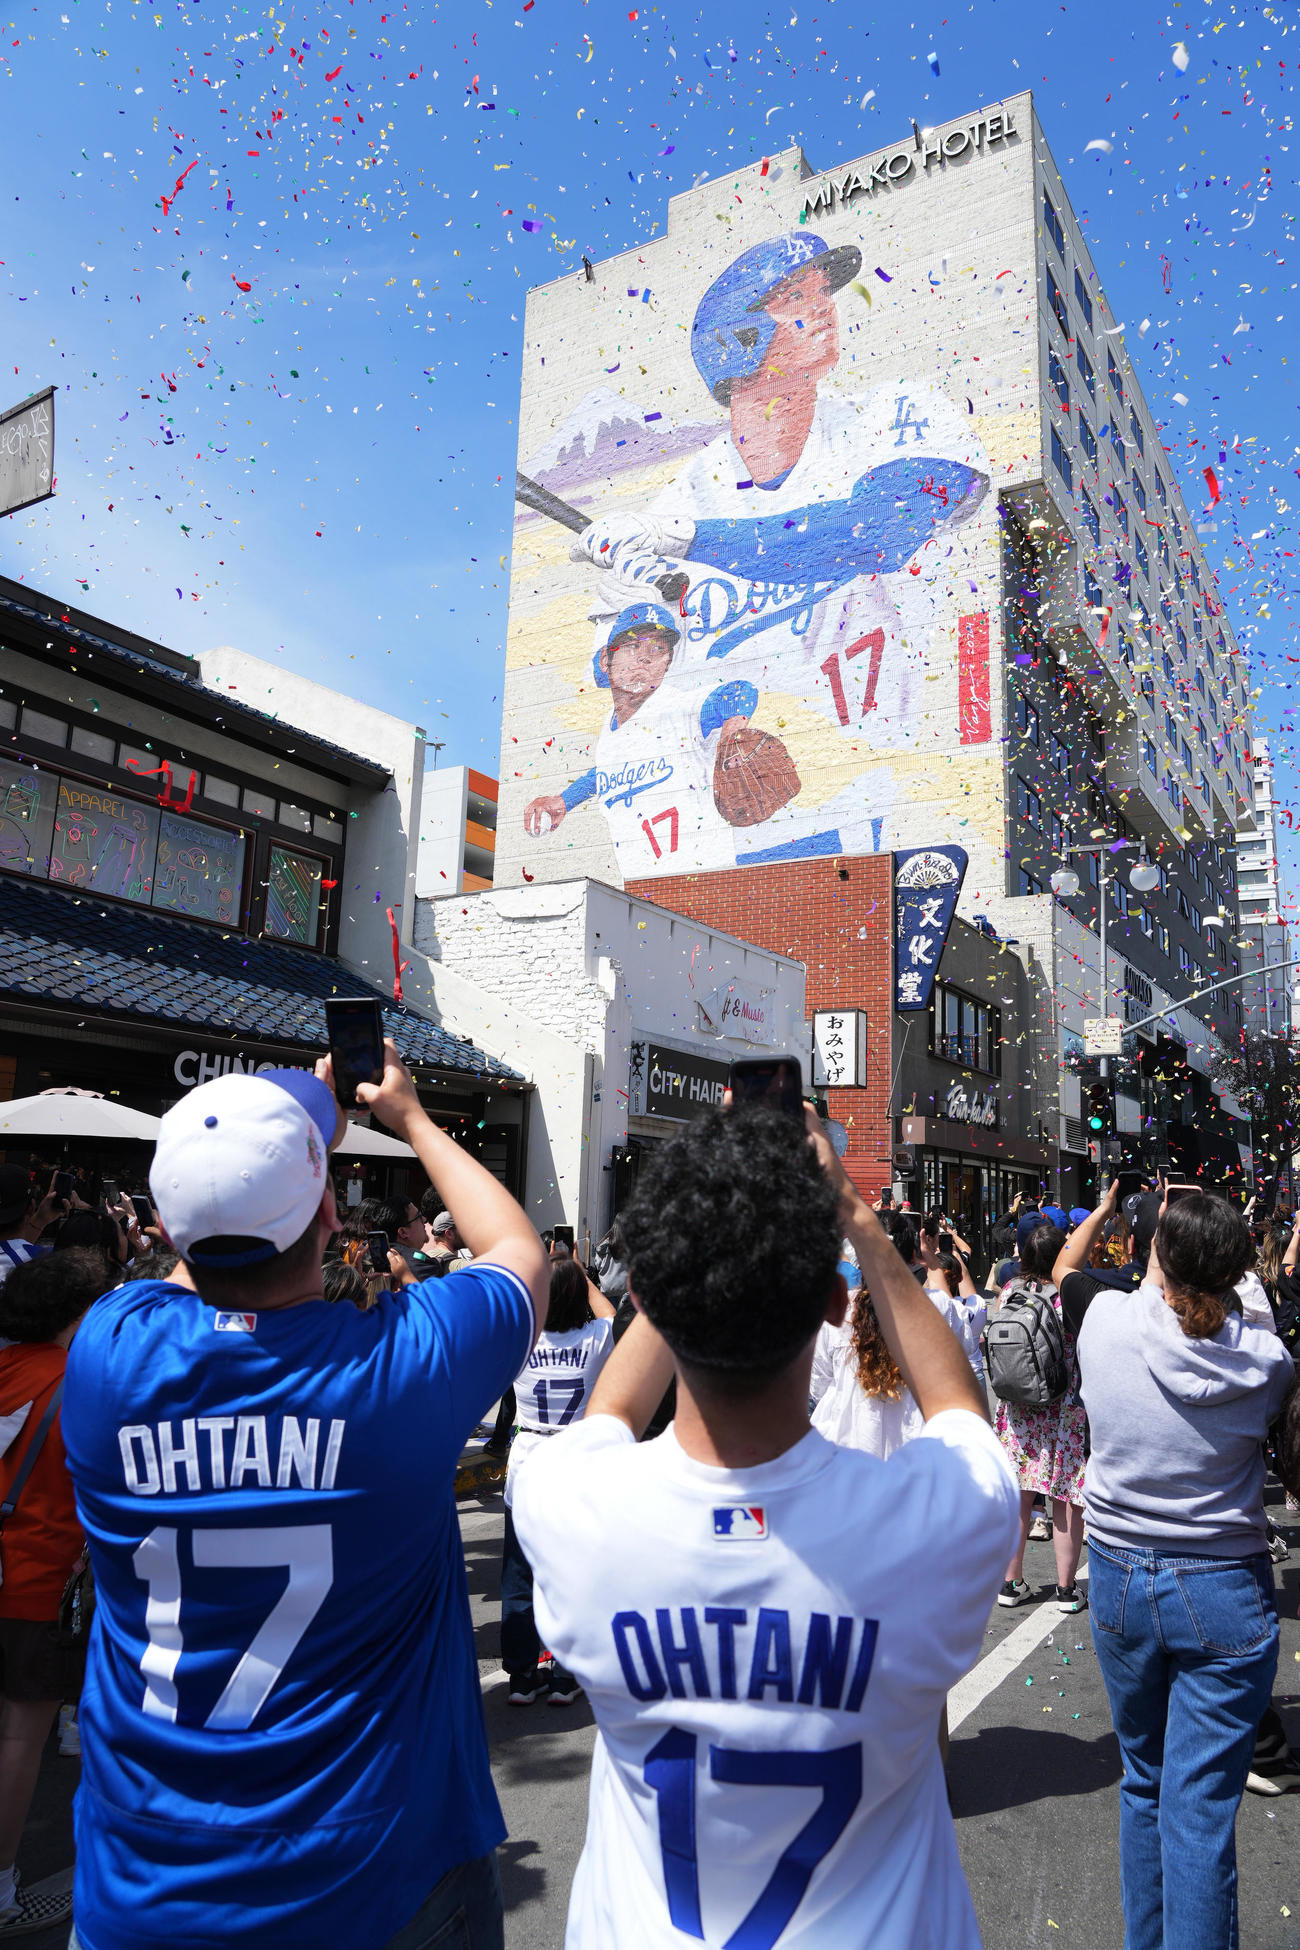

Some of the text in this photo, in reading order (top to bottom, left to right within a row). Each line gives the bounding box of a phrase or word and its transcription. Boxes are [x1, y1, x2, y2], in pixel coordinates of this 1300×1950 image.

[803, 111, 1017, 213] MIYAKO HOTEL
[889, 396, 930, 447] LA
[820, 626, 886, 727] 17
[58, 785, 129, 821] APPAREL
[596, 757, 667, 808] Dodgers
[642, 806, 679, 859] 17
[898, 898, 943, 1003] 文化堂
[732, 998, 741, 1017] &
[741, 1002, 765, 1024] Music
[825, 1015, 845, 1083] おみやげ
[649, 1067, 688, 1098] CITY
[689, 1077, 725, 1106] HAIR
[528, 1347, 589, 1369] OHTANI
[532, 1377, 585, 1426] 17
[118, 1415, 346, 1496] OHTANI
[132, 1523, 334, 1731] 17
[611, 1606, 880, 1713] OHTANI
[643, 1725, 863, 1950] 17
